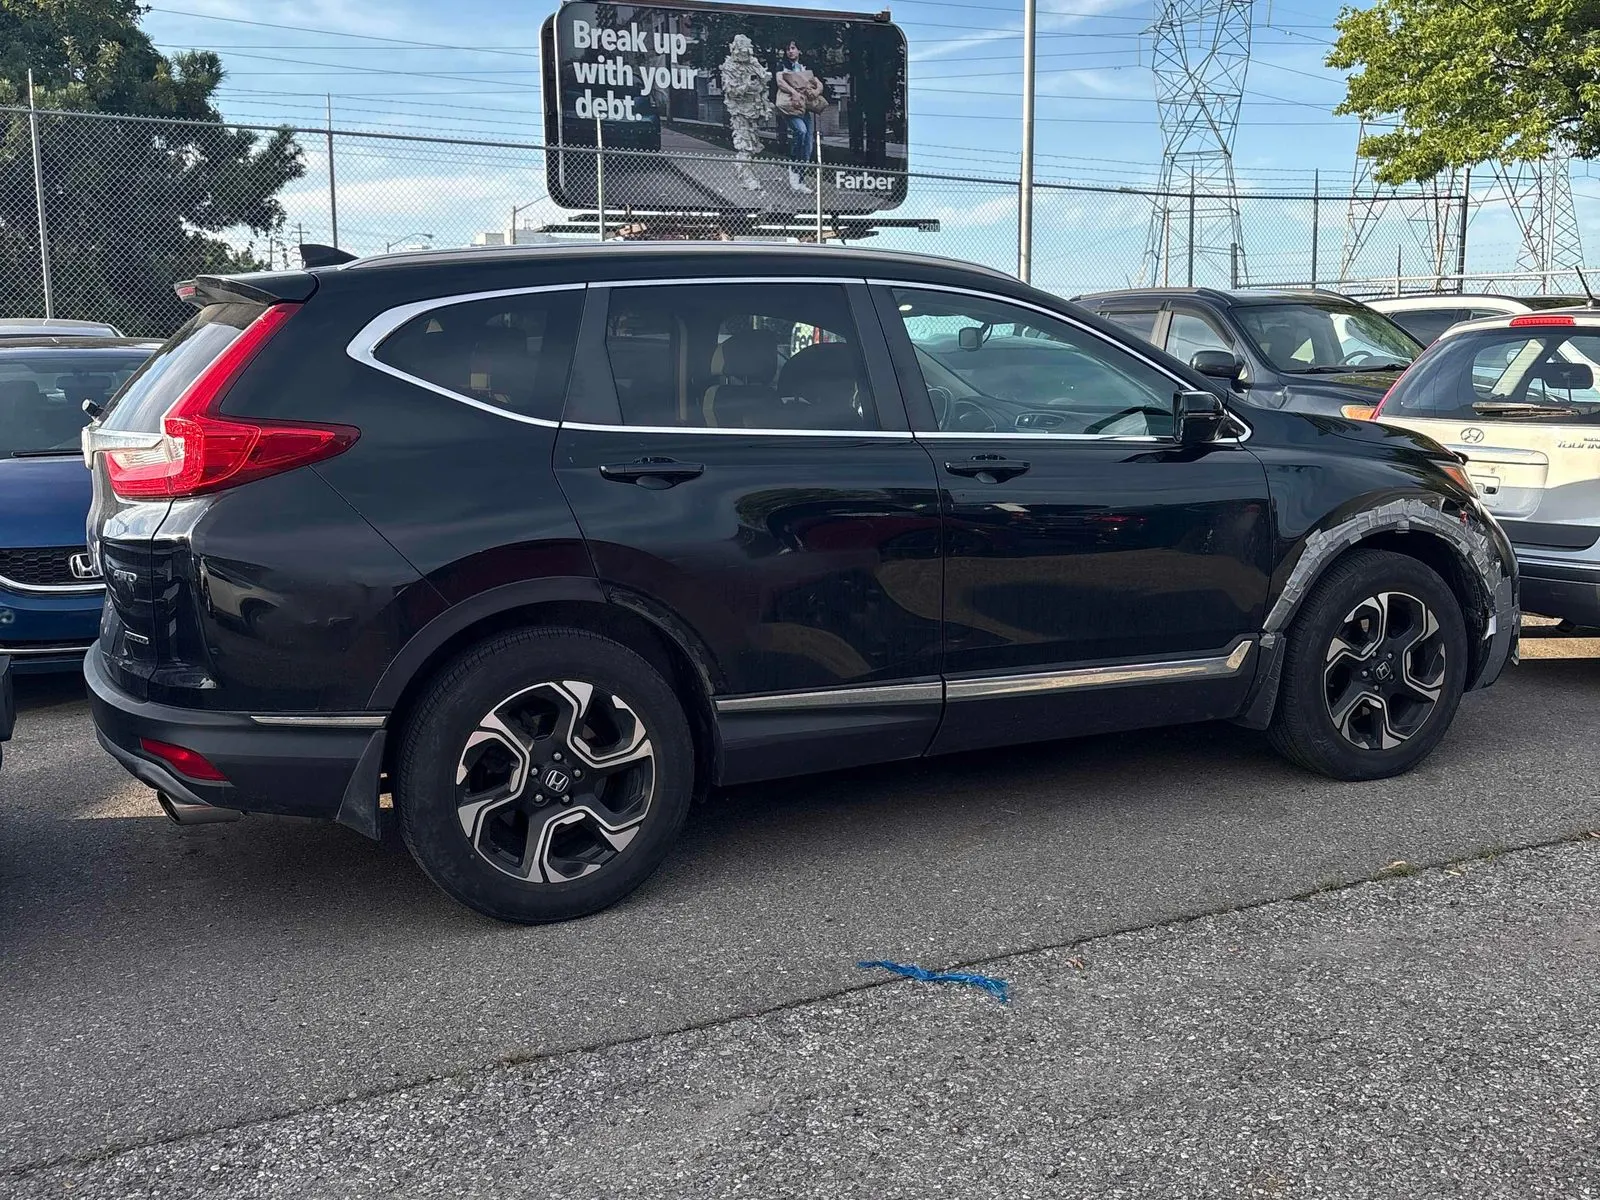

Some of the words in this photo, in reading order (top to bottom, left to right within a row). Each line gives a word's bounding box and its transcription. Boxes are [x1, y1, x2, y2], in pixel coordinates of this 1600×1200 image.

[573, 20, 648, 53] Break
[653, 32, 687, 63] up
[573, 55, 633, 86] with
[639, 66, 698, 96] your
[575, 89, 643, 121] debt.
[836, 171, 896, 190] Farber
[919, 223, 940, 232] 3200
